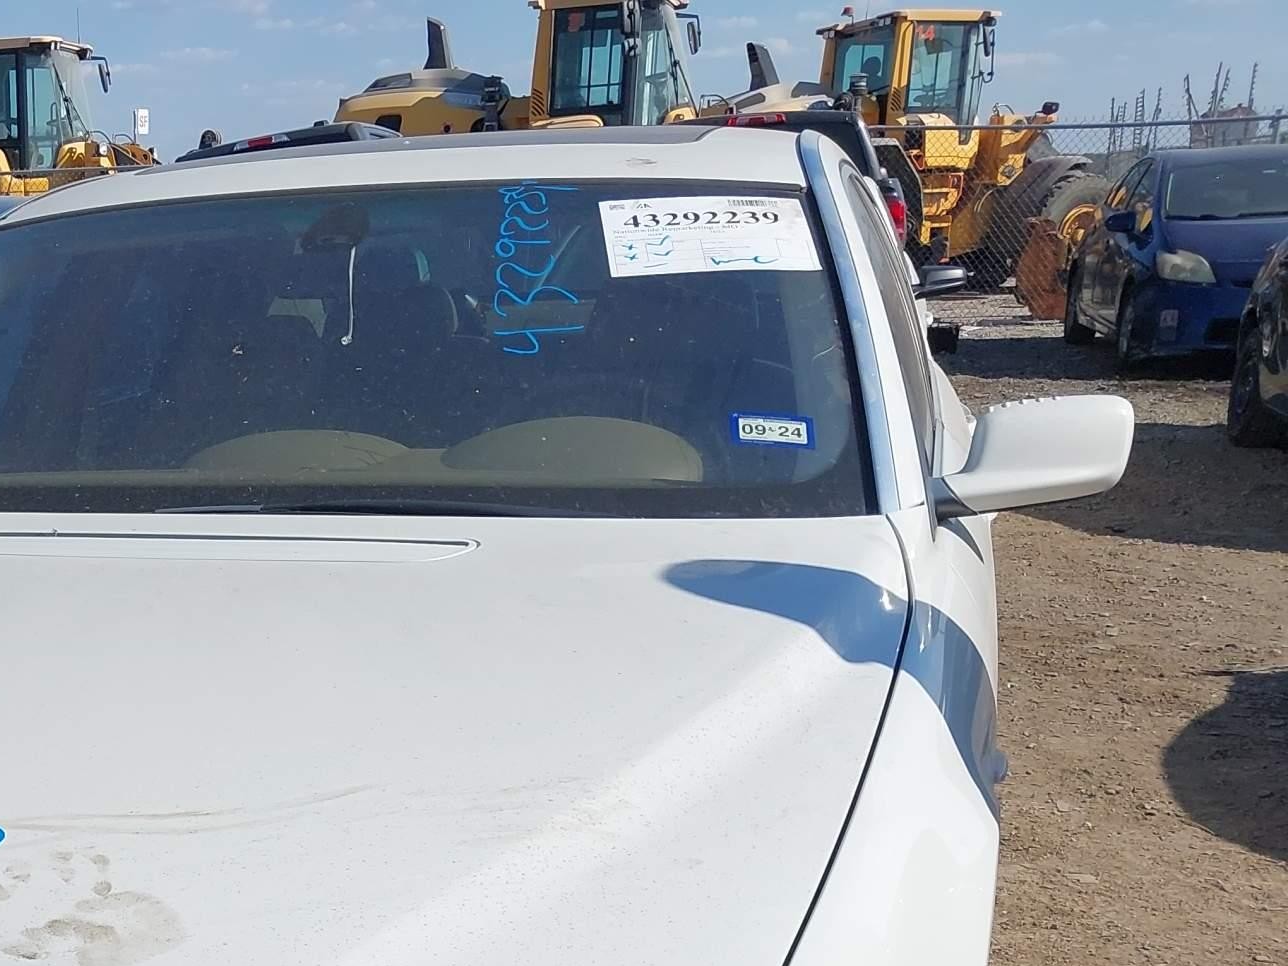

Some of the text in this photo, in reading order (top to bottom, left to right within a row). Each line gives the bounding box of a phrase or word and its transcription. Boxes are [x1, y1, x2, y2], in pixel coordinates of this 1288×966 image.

[623, 211, 780, 229] 43292239
[741, 423, 803, 438] 09 24
